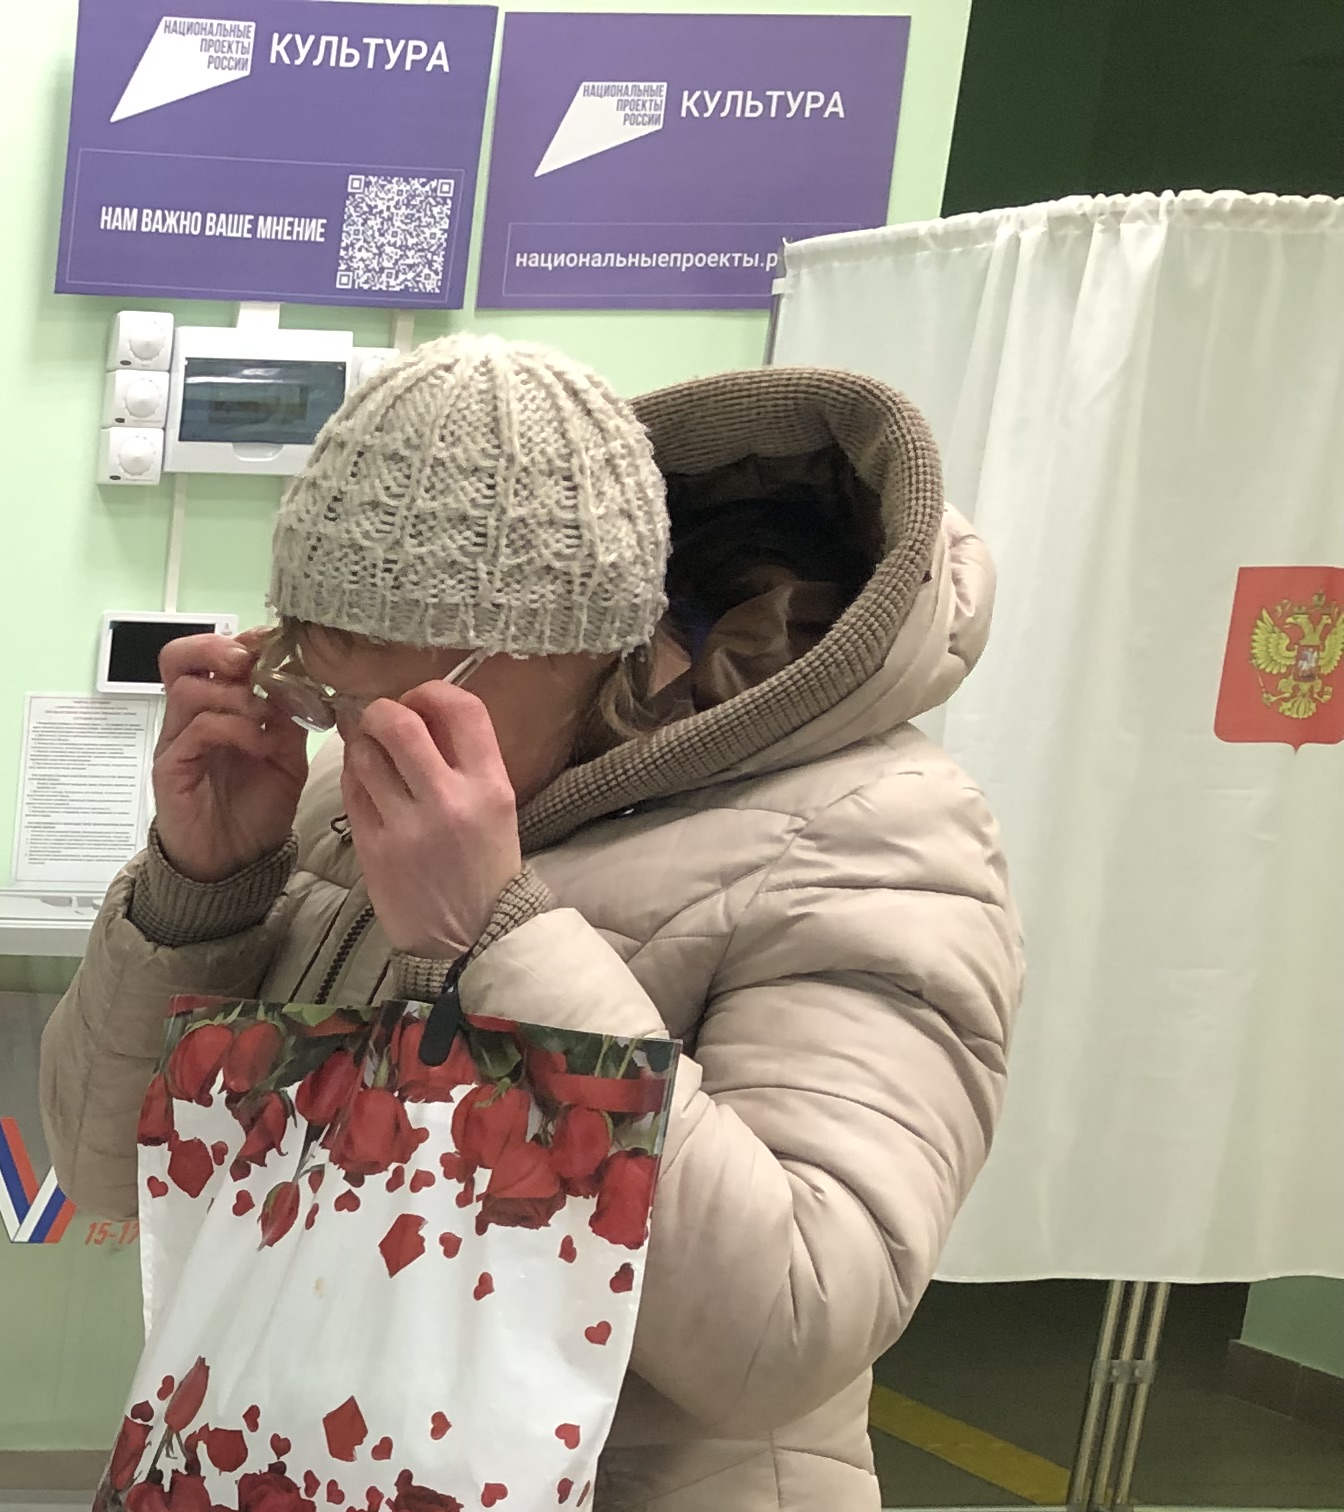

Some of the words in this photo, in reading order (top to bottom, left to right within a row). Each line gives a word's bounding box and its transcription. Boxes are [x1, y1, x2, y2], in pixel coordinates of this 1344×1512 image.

[163, 19, 253, 39] НАЦИОНАЛЬНЫЕ
[199, 39, 251, 56] ПРОЕКТЫ
[268, 32, 451, 73] КУЛЬТУРА
[206, 55, 250, 72] РОССИИ
[582, 83, 665, 99] НАЦИОНАЛЬНЫЕ
[615, 98, 663, 112] ПРОЕКТЫ
[679, 89, 846, 119] КУЛЬТУРА
[622, 112, 662, 127] РОССИИ
[99, 205, 139, 231] НАМ
[140, 208, 202, 235] ВАЖНО
[204, 212, 254, 238] ВАШЕ
[256, 215, 327, 242] МНЕНИЕ
[515, 251, 779, 273] национальныепроекты.р
